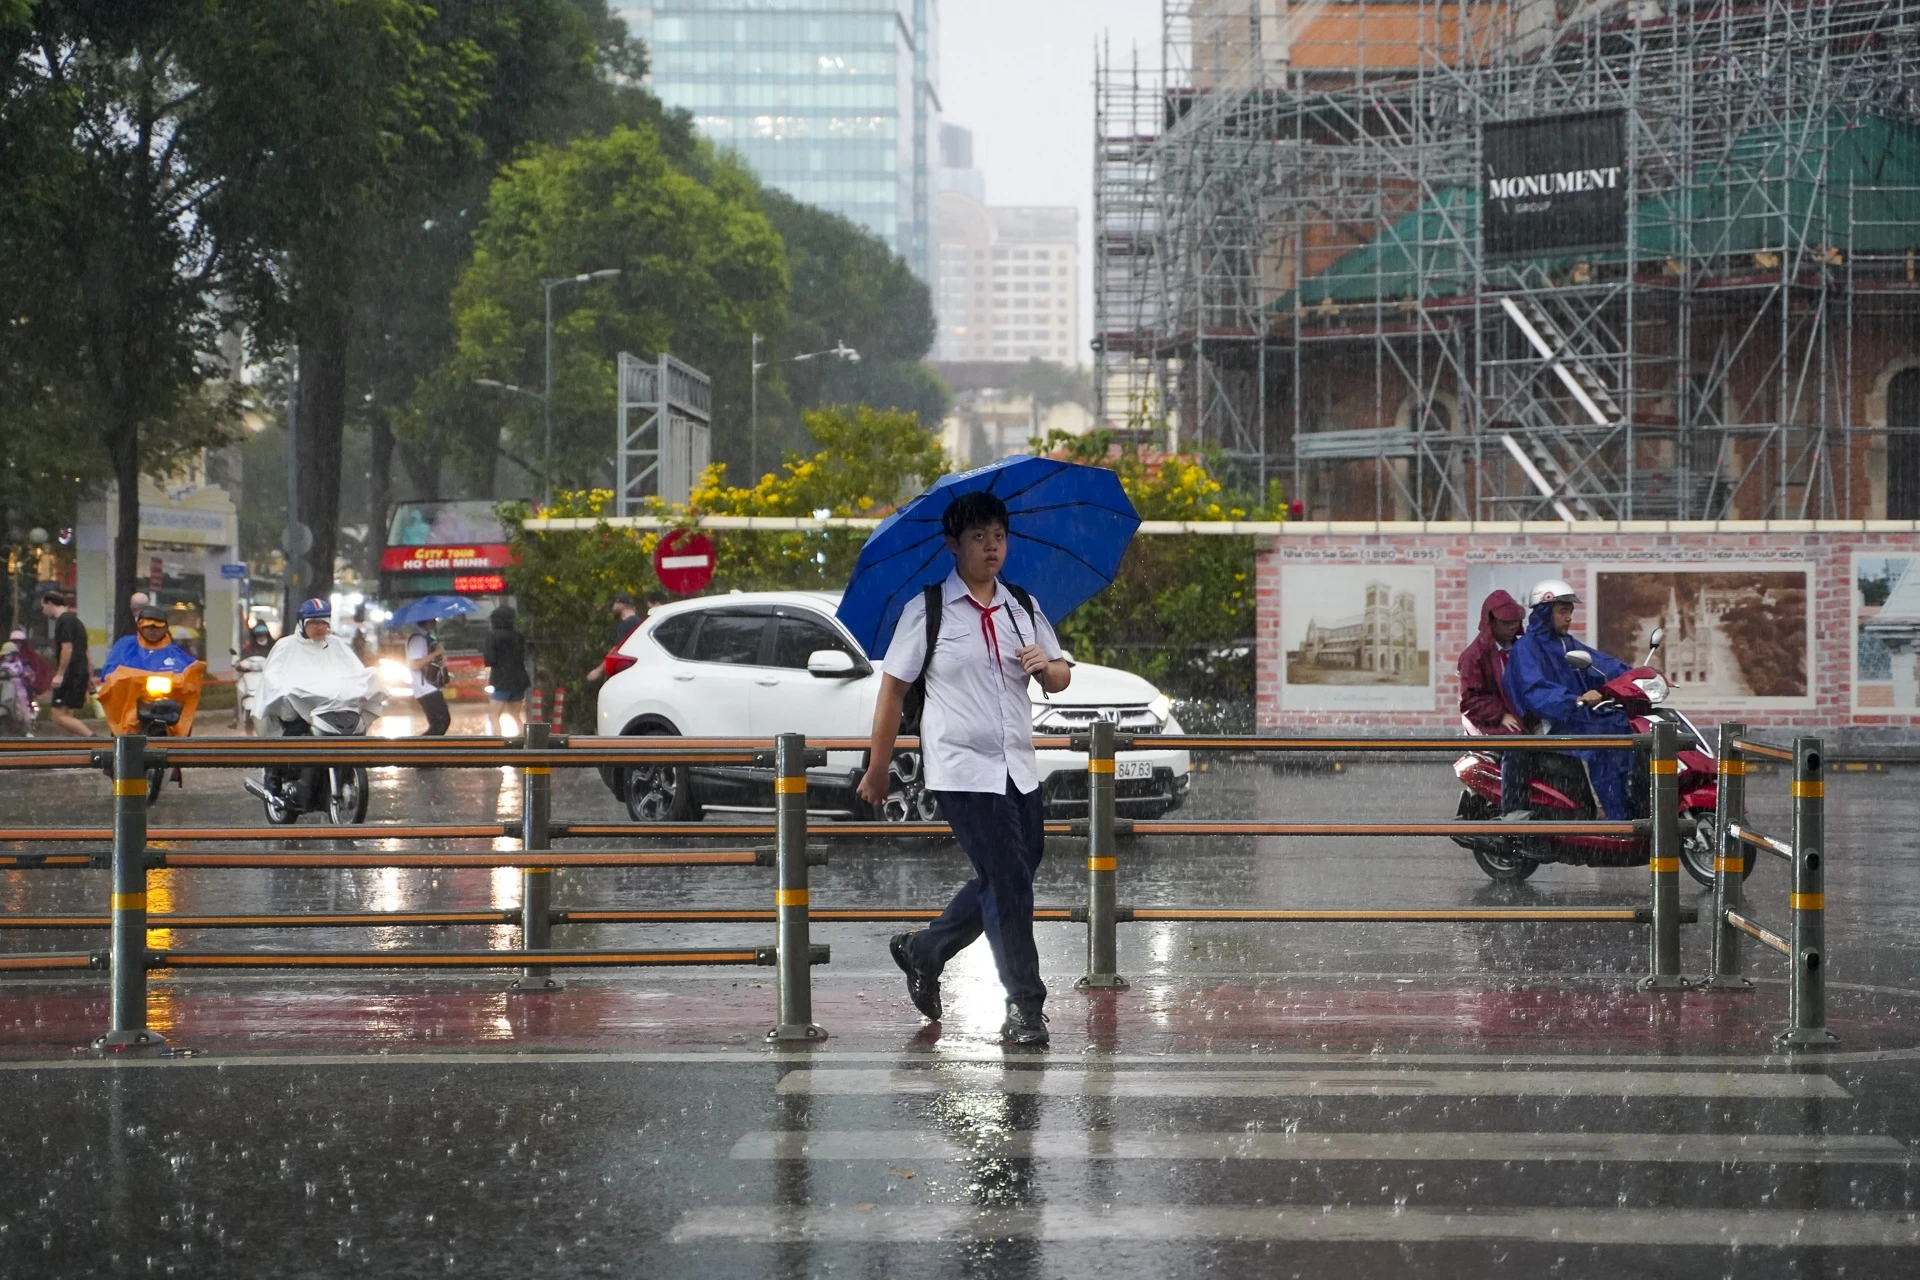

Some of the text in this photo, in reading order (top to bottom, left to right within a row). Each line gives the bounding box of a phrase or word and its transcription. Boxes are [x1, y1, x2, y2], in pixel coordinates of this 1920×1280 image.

[1488, 166, 1621, 200] MONUMENT
[447, 548, 475, 558] TOUR
[403, 557, 488, 569] HO CHI MINH
[1118, 762, 1151, 778] 647.63
